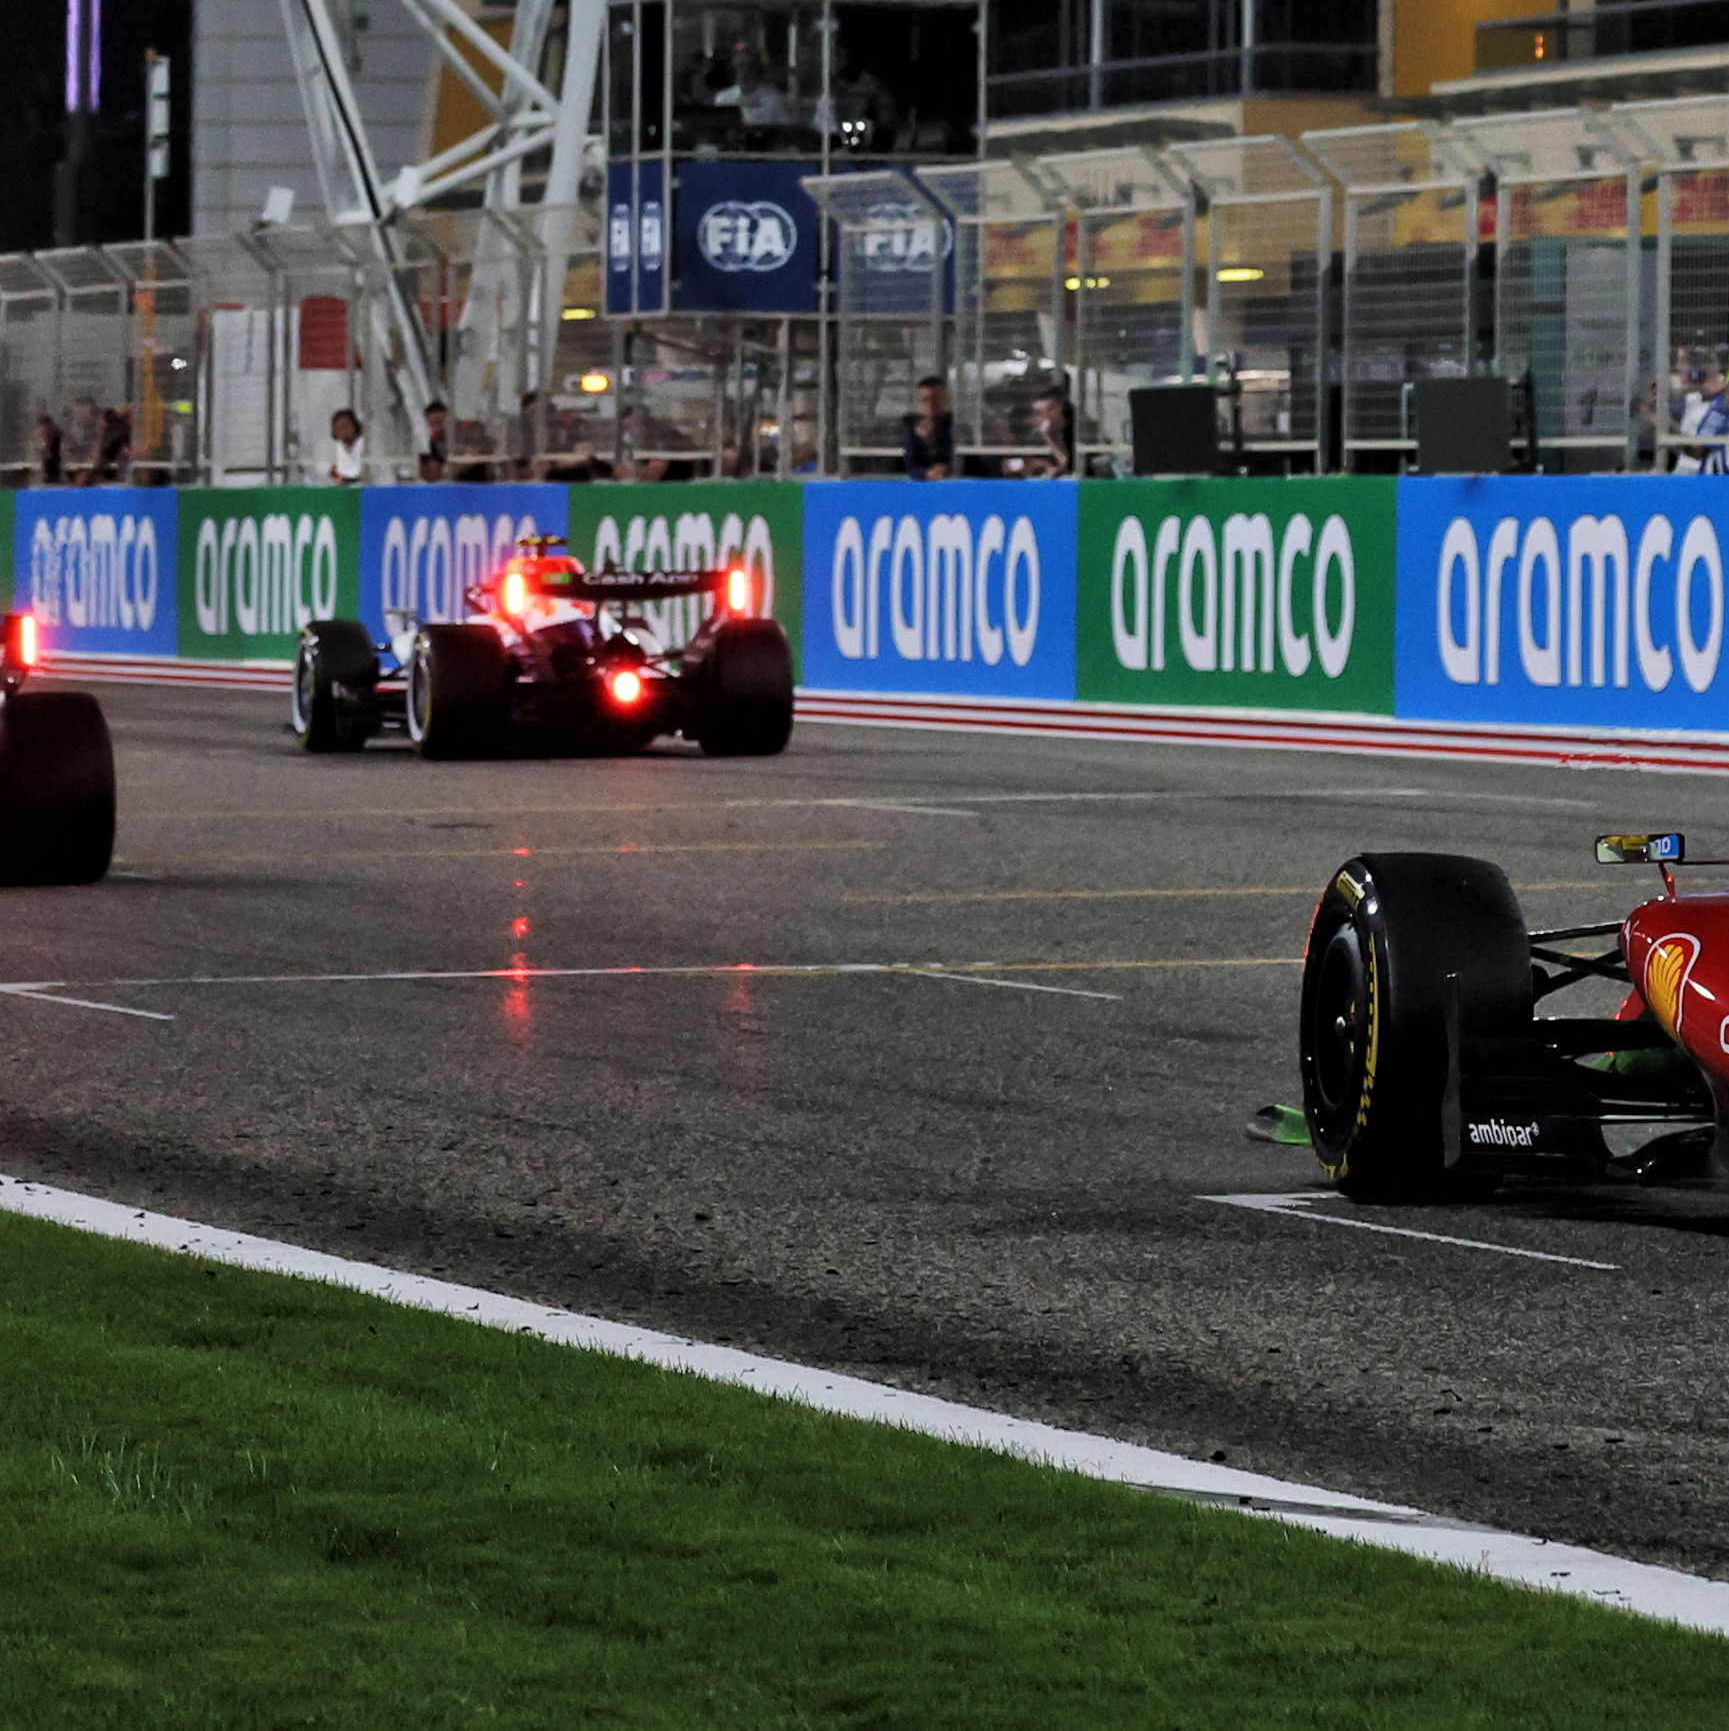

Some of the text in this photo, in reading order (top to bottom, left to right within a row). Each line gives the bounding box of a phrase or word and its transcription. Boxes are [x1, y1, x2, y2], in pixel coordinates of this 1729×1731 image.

[706, 216, 786, 258] FIA
[32, 514, 157, 631] aramco
[195, 513, 337, 635] aramco
[381, 513, 537, 636] aram
[831, 513, 1040, 666] aramco
[1111, 512, 1354, 678] aramco
[1437, 514, 1724, 694] aramco
[1468, 1118, 1533, 1149] ambipar
